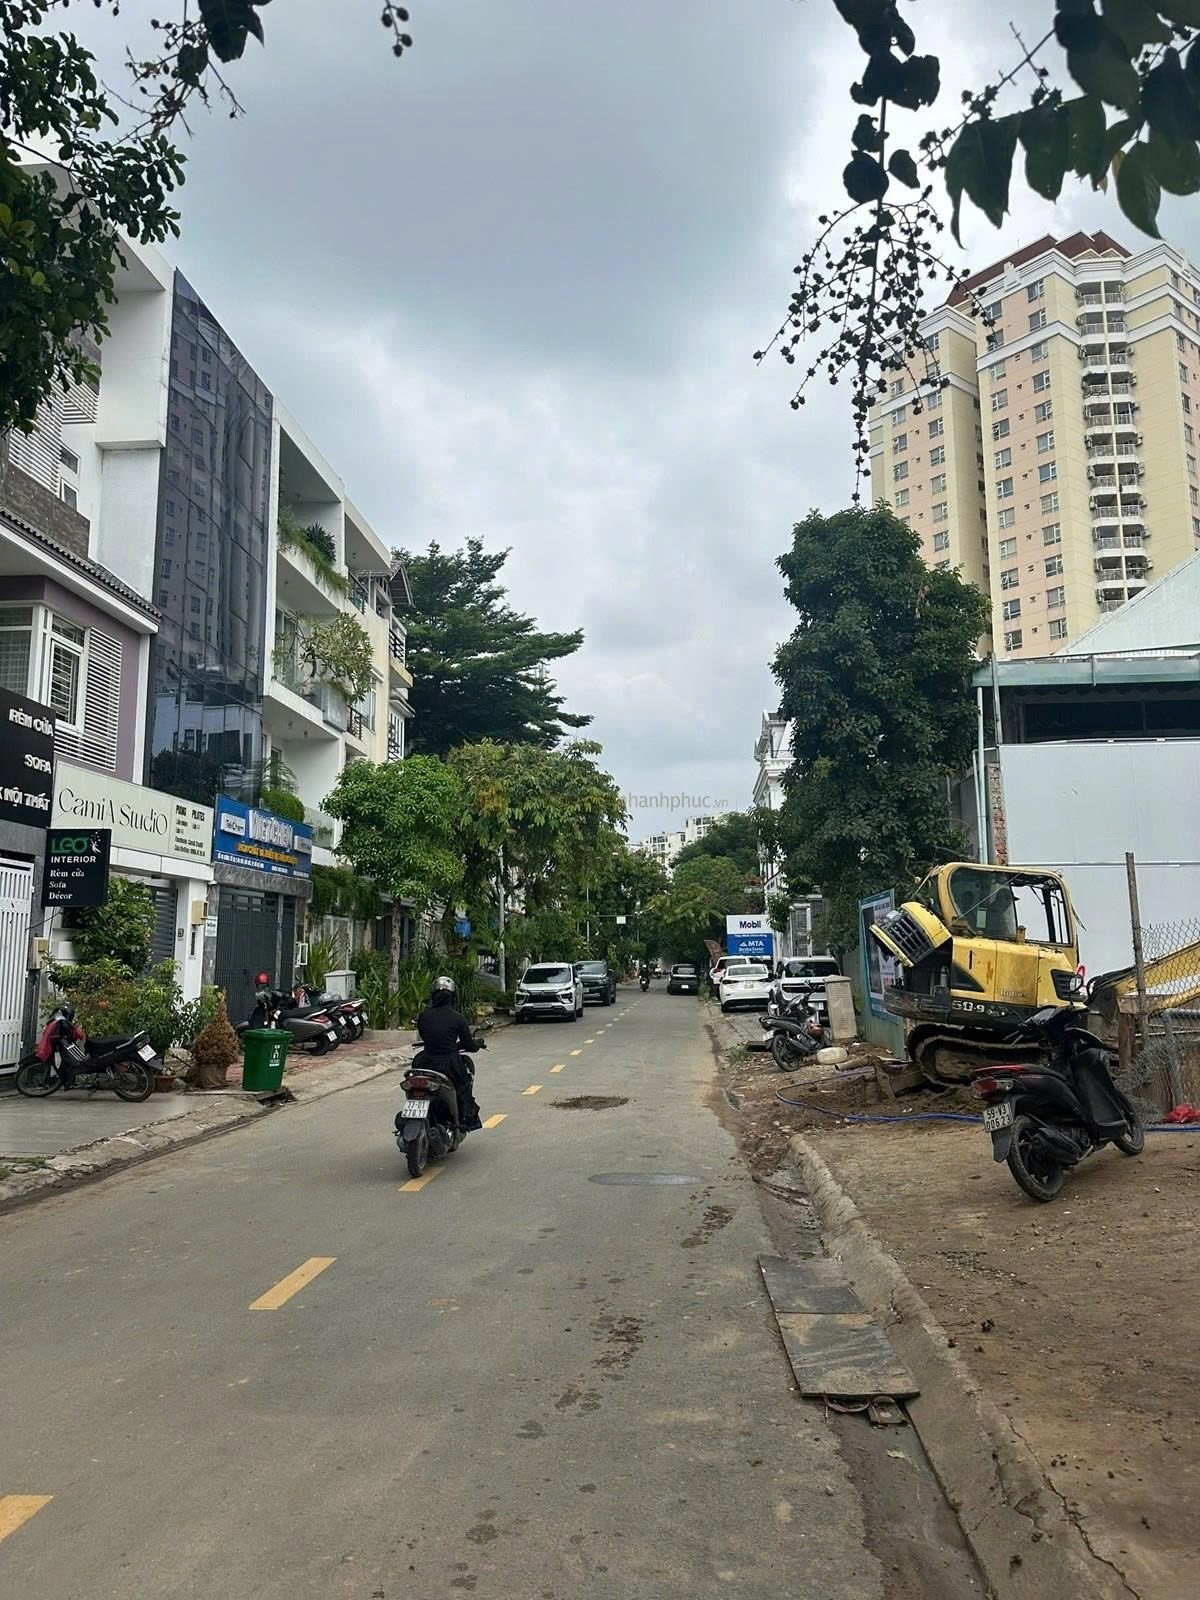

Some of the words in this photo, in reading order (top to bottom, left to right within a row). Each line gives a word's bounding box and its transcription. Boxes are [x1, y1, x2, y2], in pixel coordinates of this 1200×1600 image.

[24, 753, 52, 774] SOFA
[4, 787, 23, 807] NỘI
[24, 793, 51, 811] THẤT
[50, 855, 97, 864] INTERIOR
[49, 880, 67, 889] Sofa
[48, 891, 73, 901] Décor
